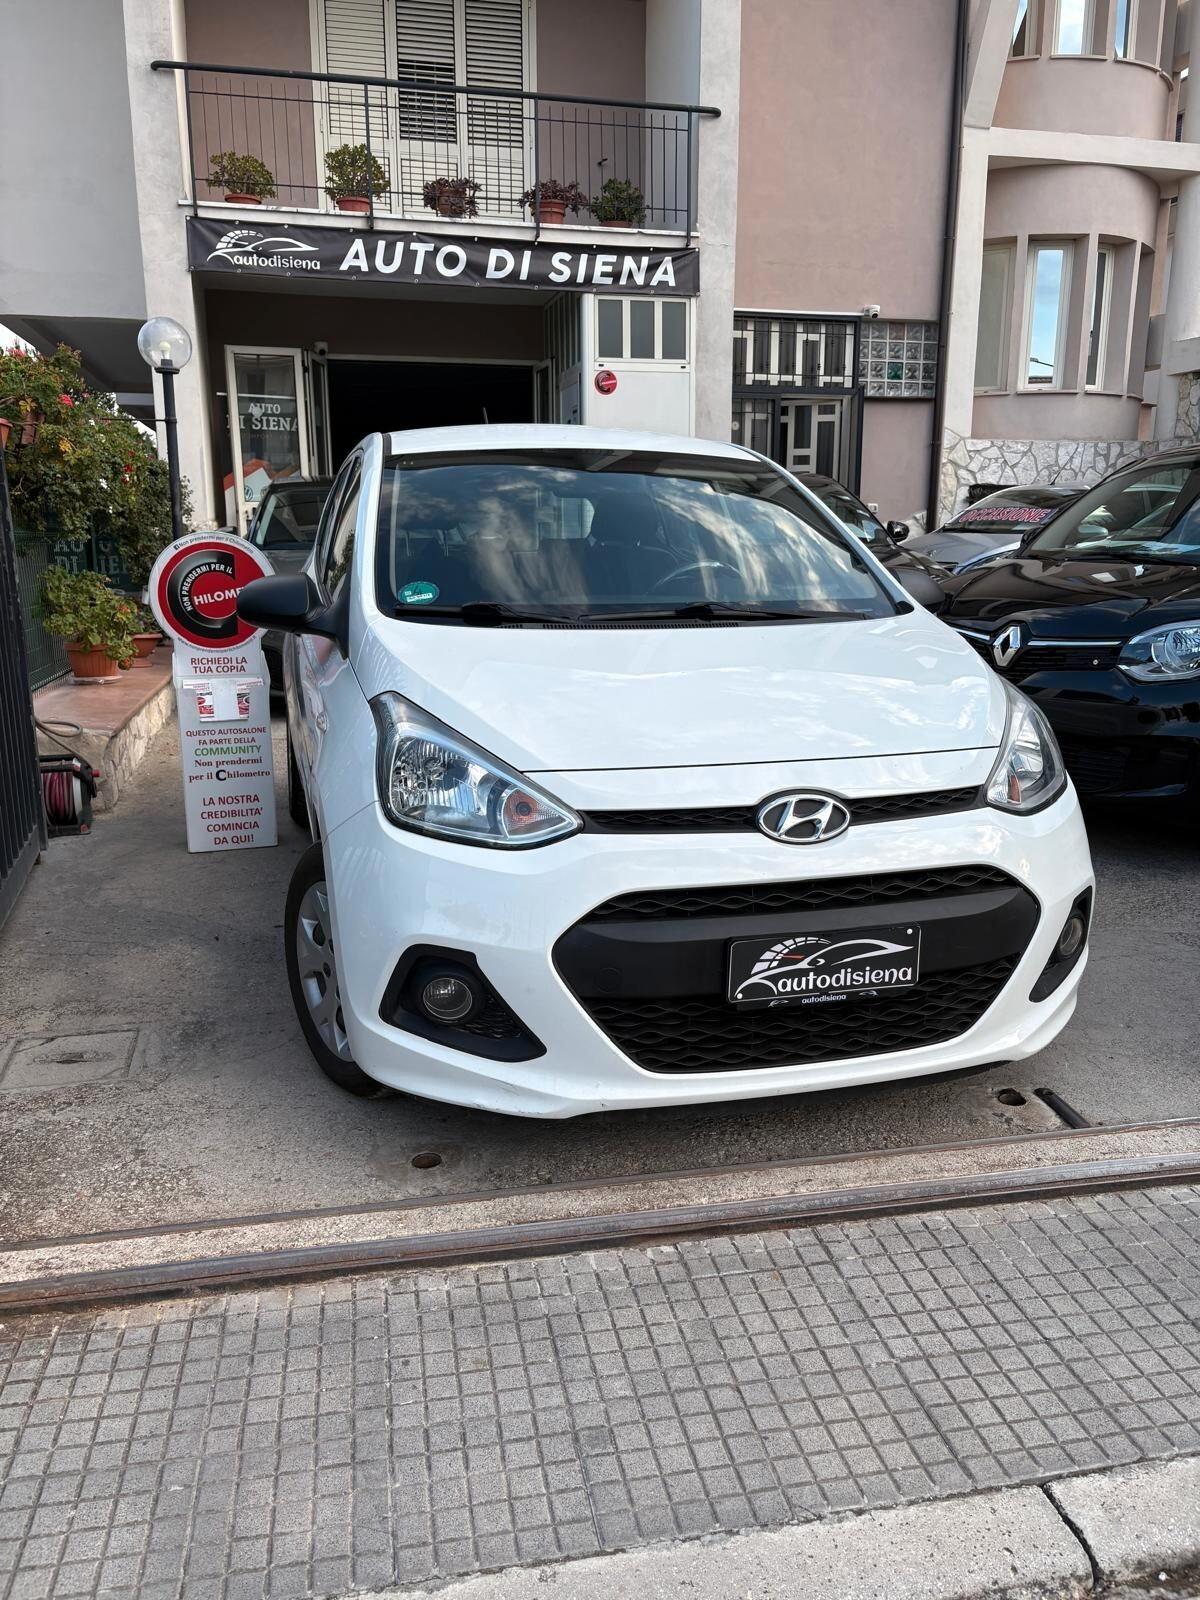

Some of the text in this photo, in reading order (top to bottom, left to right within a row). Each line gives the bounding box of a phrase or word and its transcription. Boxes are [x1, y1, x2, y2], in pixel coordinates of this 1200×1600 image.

[233, 253, 321, 271] autodisiena
[339, 238, 676, 287] AUTO DI SIENA
[959, 507, 1052, 523] OCCASIONE
[182, 563, 233, 612] NON PRENDERMI PER IL
[190, 656, 248, 666] RICHIEDI LA
[193, 665, 246, 674] TUA COPIA
[186, 727, 267, 737] QUESTO AUTOSALONE
[194, 745, 262, 757] COMMUNITY
[194, 756, 263, 768] Non prendermi
[189, 769, 271, 783] per il Chilometro
[203, 794, 260, 806] LA NOSTRA
[200, 807, 263, 820] CREDIBILITA'
[206, 821, 260, 833] COMINCIA
[214, 834, 255, 846] DA QUI!
[777, 966, 912, 992] autodisiena
[801, 993, 847, 1004] autodisiena
